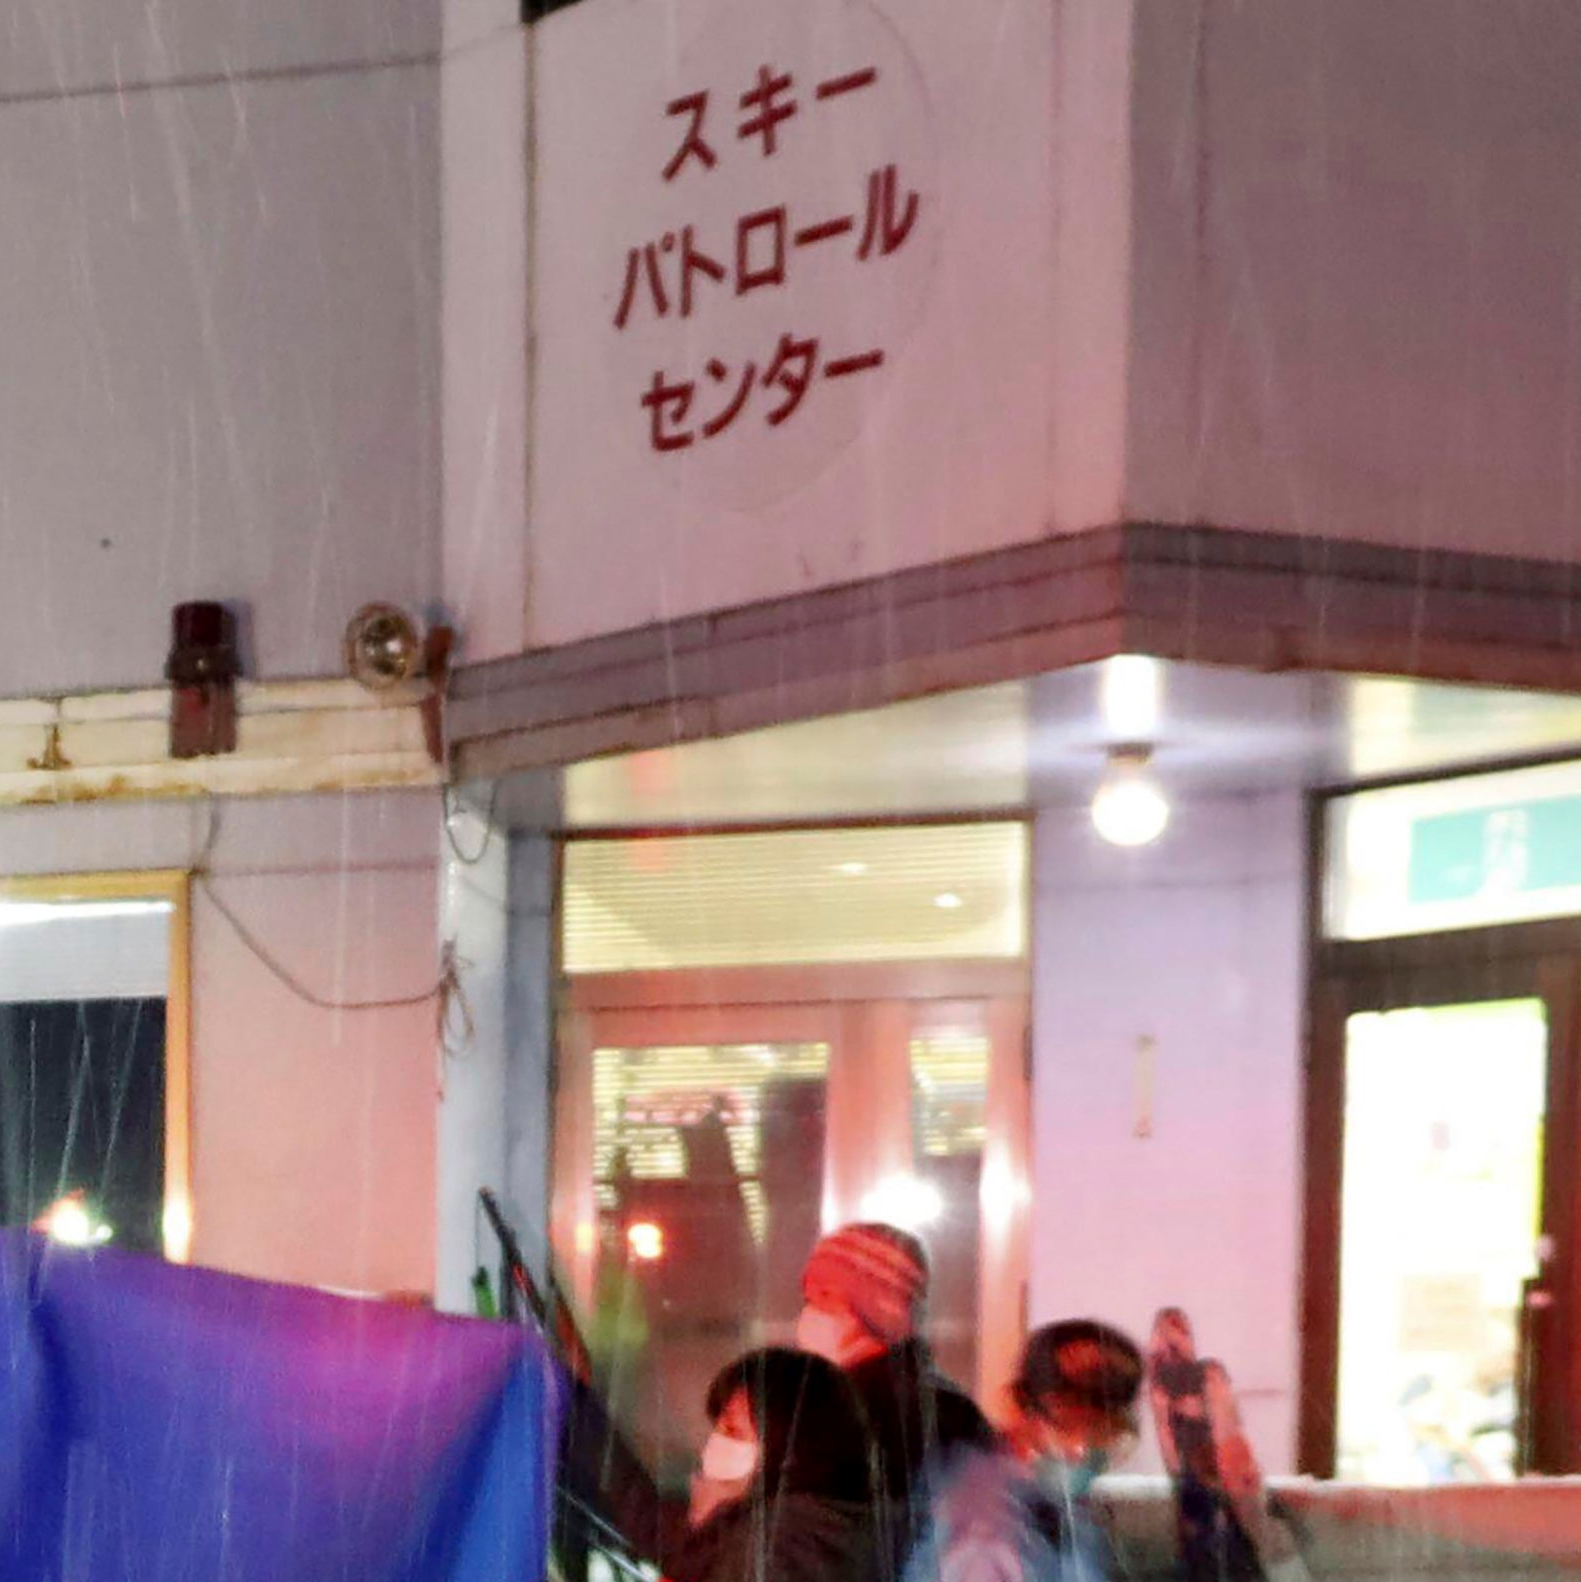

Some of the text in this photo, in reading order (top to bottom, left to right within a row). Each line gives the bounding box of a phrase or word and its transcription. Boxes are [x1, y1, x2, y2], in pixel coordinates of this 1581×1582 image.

[661, 64, 877, 182] スキー
[613, 163, 920, 330] パトロール
[641, 332, 885, 452] センター
